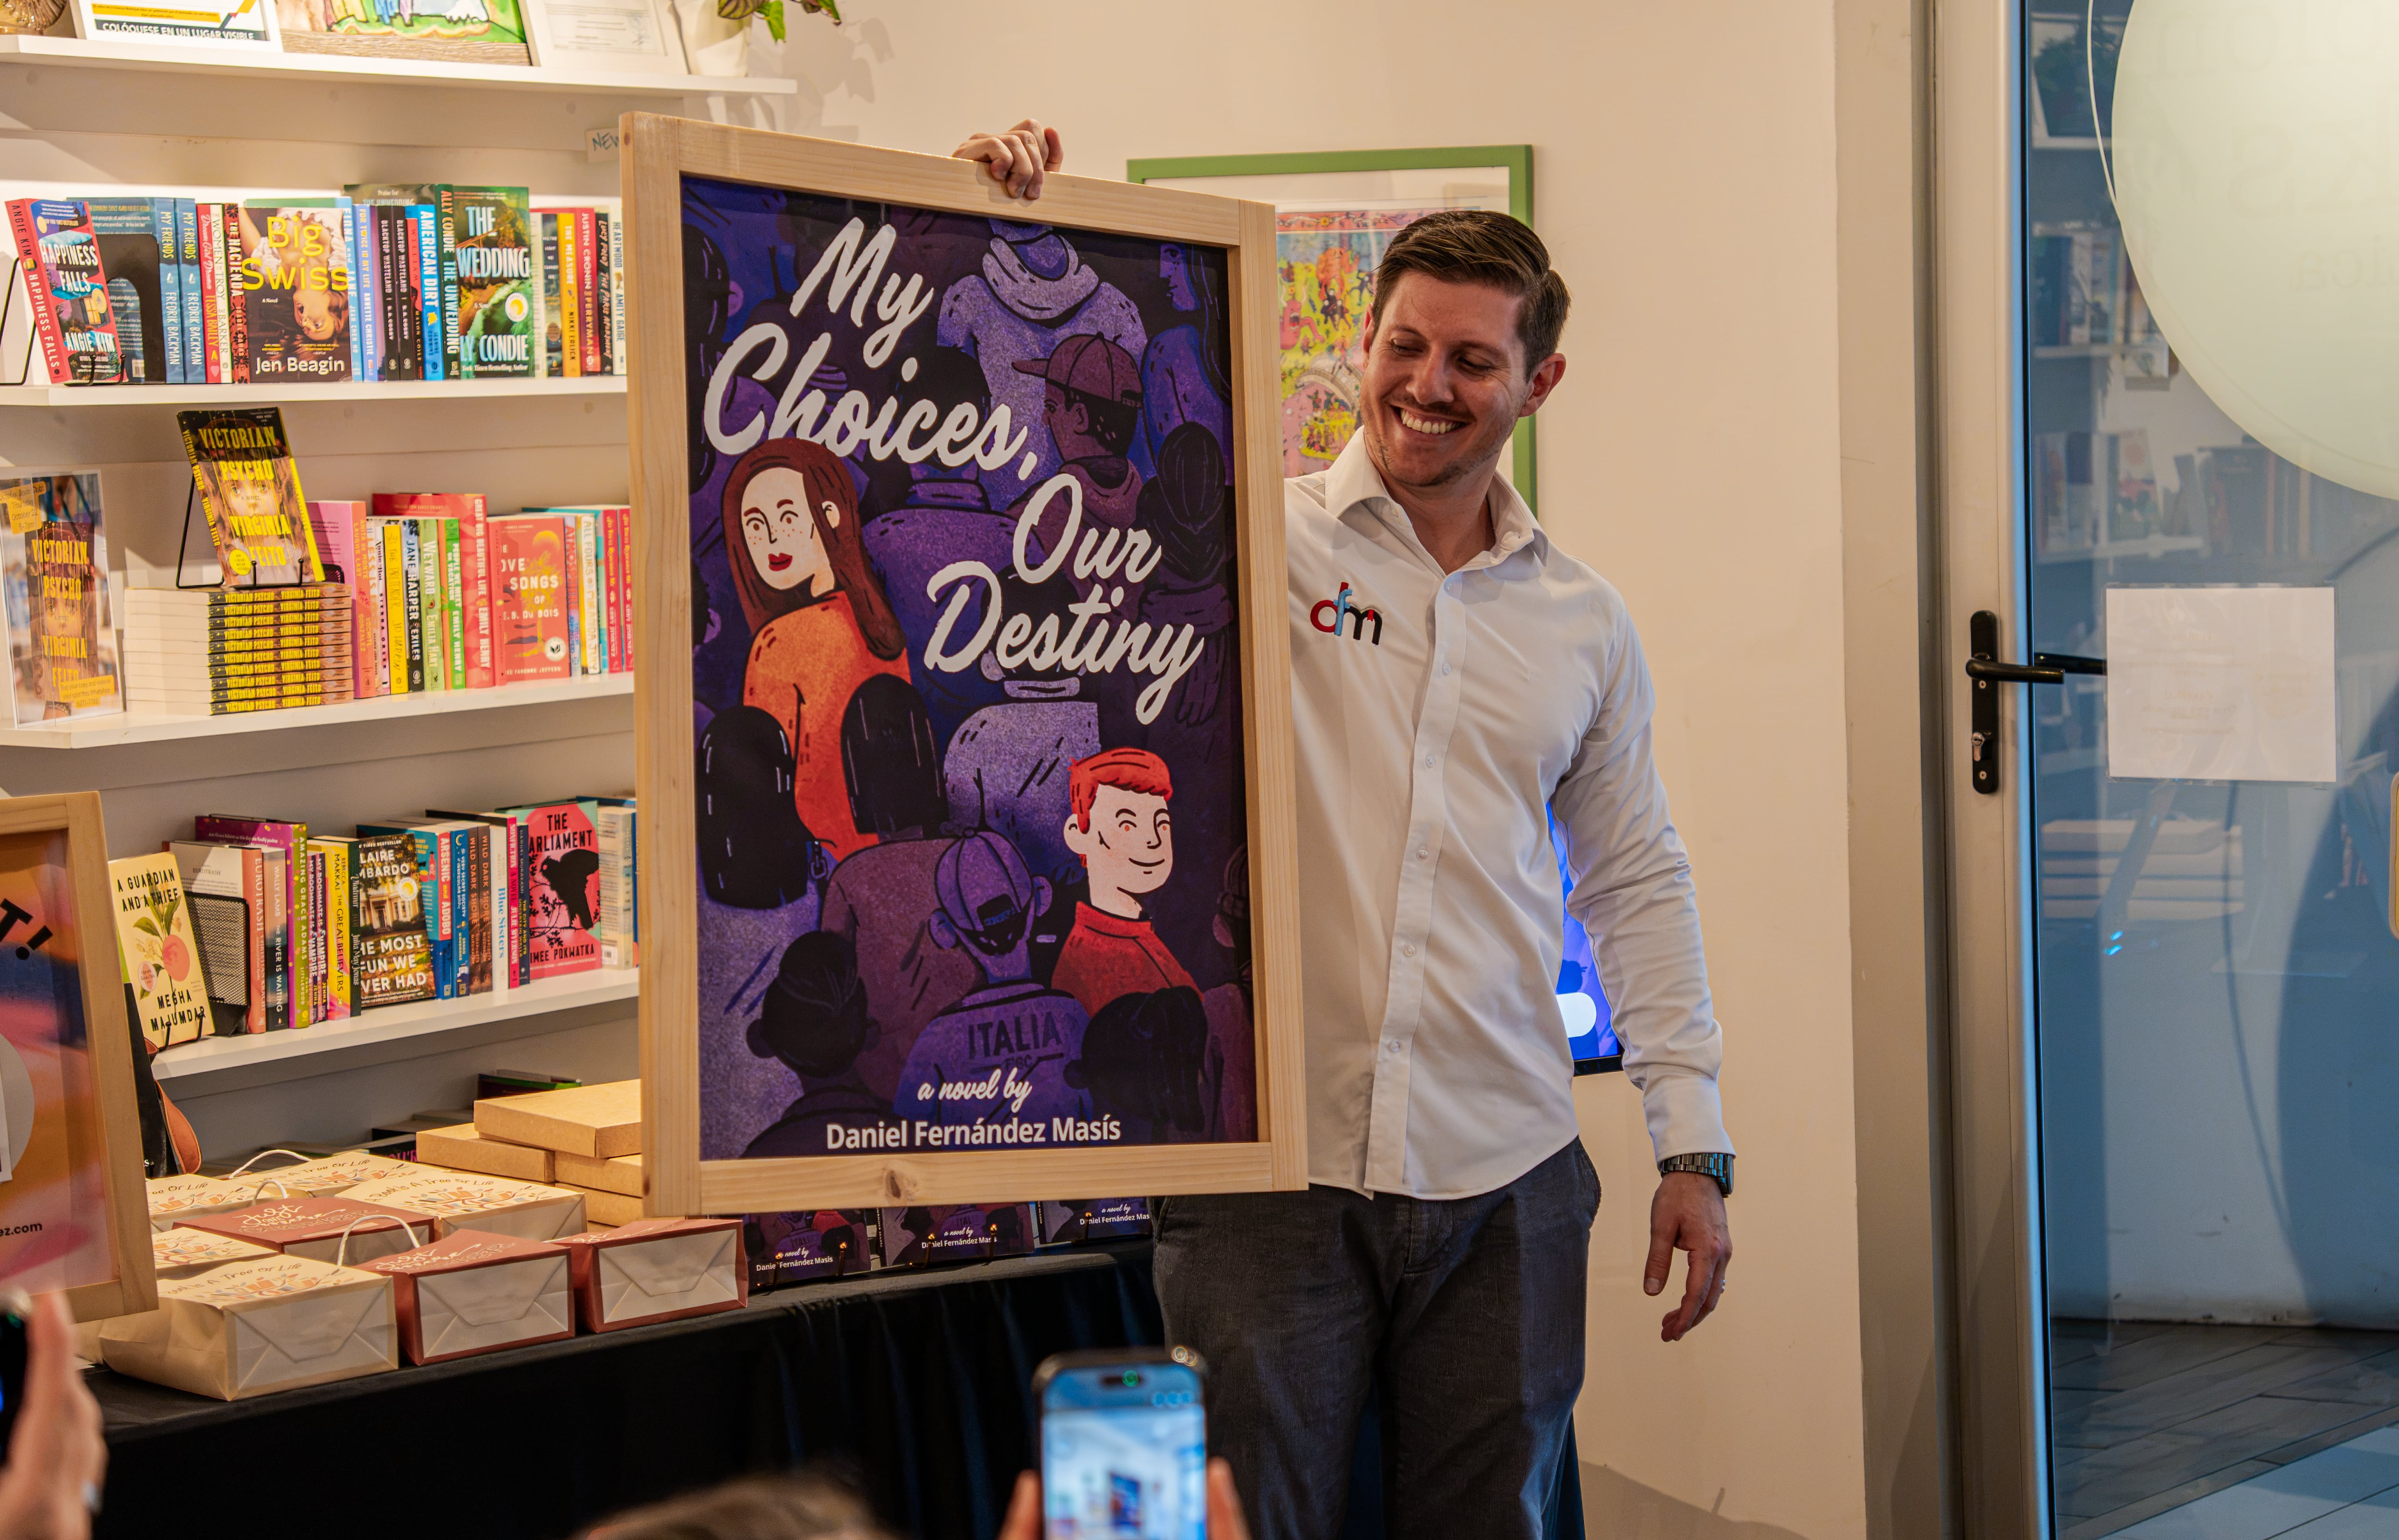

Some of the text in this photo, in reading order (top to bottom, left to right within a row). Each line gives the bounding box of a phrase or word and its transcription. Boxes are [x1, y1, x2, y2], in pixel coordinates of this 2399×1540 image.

[161, 26, 175, 36] EN
[176, 27, 191, 37] UN
[191, 28, 222, 39] LUGAR
[222, 31, 254, 41] VISIBLE
[465, 206, 498, 237] THE
[267, 215, 324, 257] Big
[613, 222, 622, 268] HEARTWOOD
[39, 243, 98, 266] HAPPINESS
[212, 218, 225, 300] WOMEN TROY
[228, 222, 244, 296] THE HACIENDA
[420, 211, 439, 308] AMERICAN DIRT
[565, 244, 574, 284] MEASURE
[582, 213, 592, 289] JUSTIN CRONIN
[59, 271, 91, 292] FALLS
[241, 257, 348, 291] Swiss
[440, 190, 460, 354] ALLY CONDIE THE UNWEDDING
[12, 205, 60, 367] ANGIE KIM HAPPINESS FALLS
[161, 212, 180, 365] MY FRIENDS FREDRIK BACKMAN
[183, 212, 202, 365] MY FRIENDS FREDRIK BACKMAN
[789, 217, 934, 368] My
[205, 295, 218, 347] TESSA BAILEY
[585, 297, 594, 355] FERRYMAN
[615, 294, 625, 342] AMITY GAIGE
[65, 332, 116, 352] ANGIE KIM
[218, 314, 228, 353] BARKER
[479, 334, 530, 362] CONDIE
[256, 355, 345, 375] Jen Beagin
[703, 322, 1038, 481] Choices,
[198, 426, 277, 449] VICTORIAN
[220, 459, 275, 481] PSYCHO
[182, 429, 221, 547] VICTORIAN PSYCHO VIRGINIA FEITO
[229, 514, 291, 536] VIRGINIA
[1013, 473, 1161, 583] Our
[31, 539, 88, 565] VICTORIAN
[248, 546, 287, 567] FEITO
[406, 540, 420, 620] JANE HARPER
[423, 540, 437, 595] WEYWARD
[43, 576, 82, 601] PSYCHO
[225, 589, 320, 603] VICTORIAN PSYCHO VIRGINIA FEITO
[510, 574, 560, 591] SONGS
[534, 595, 546, 605] OF
[452, 610, 461, 639] EMILY
[478, 607, 489, 635] EMILY
[42, 635, 87, 659] VIRGINIA
[411, 628, 421, 661] EXILES
[426, 614, 439, 668] EMILIA HART
[924, 560, 1205, 725] Destiny
[226, 696, 321, 712] VICTORIAN PSYCHO VIRGINIA FEITO
[546, 812, 568, 831] THE
[529, 829, 593, 853] ARLIAMENT
[359, 849, 395, 864] LAIRE
[440, 837, 451, 883] ARSENIC
[117, 879, 124, 892] A
[127, 868, 176, 889] GUARDIAN
[122, 888, 179, 912] AND A THIEF
[255, 858, 264, 932] EUROTRASH
[441, 901, 451, 935] ADOBO
[380, 935, 423, 953] MOST
[554, 943, 594, 961] POKWATKA
[392, 954, 416, 970] WE
[361, 972, 427, 993] VER HAD
[157, 989, 192, 1010] MEGHA
[151, 1006, 206, 1032] MAJUMDAR
[967, 1011, 1062, 1059] ITALIA
[918, 1067, 1033, 1113] a novel by
[826, 1114, 1122, 1149] Daniel Fernández Masís
[186, 1182, 208, 1190] Life
[1080, 1214, 1135, 1225] Dniel Fernández
[1106, 1204, 1123, 1213] novel
[1123, 1203, 1131, 1214] by
[944, 1237, 978, 1246] Fernández
[950, 1227, 965, 1236] novel
[965, 1226, 974, 1237] by
[756, 1256, 833, 1271] Danie Fernández Masís
[784, 1247, 810, 1258] novel by
[219, 1263, 303, 1279] Tree Life
